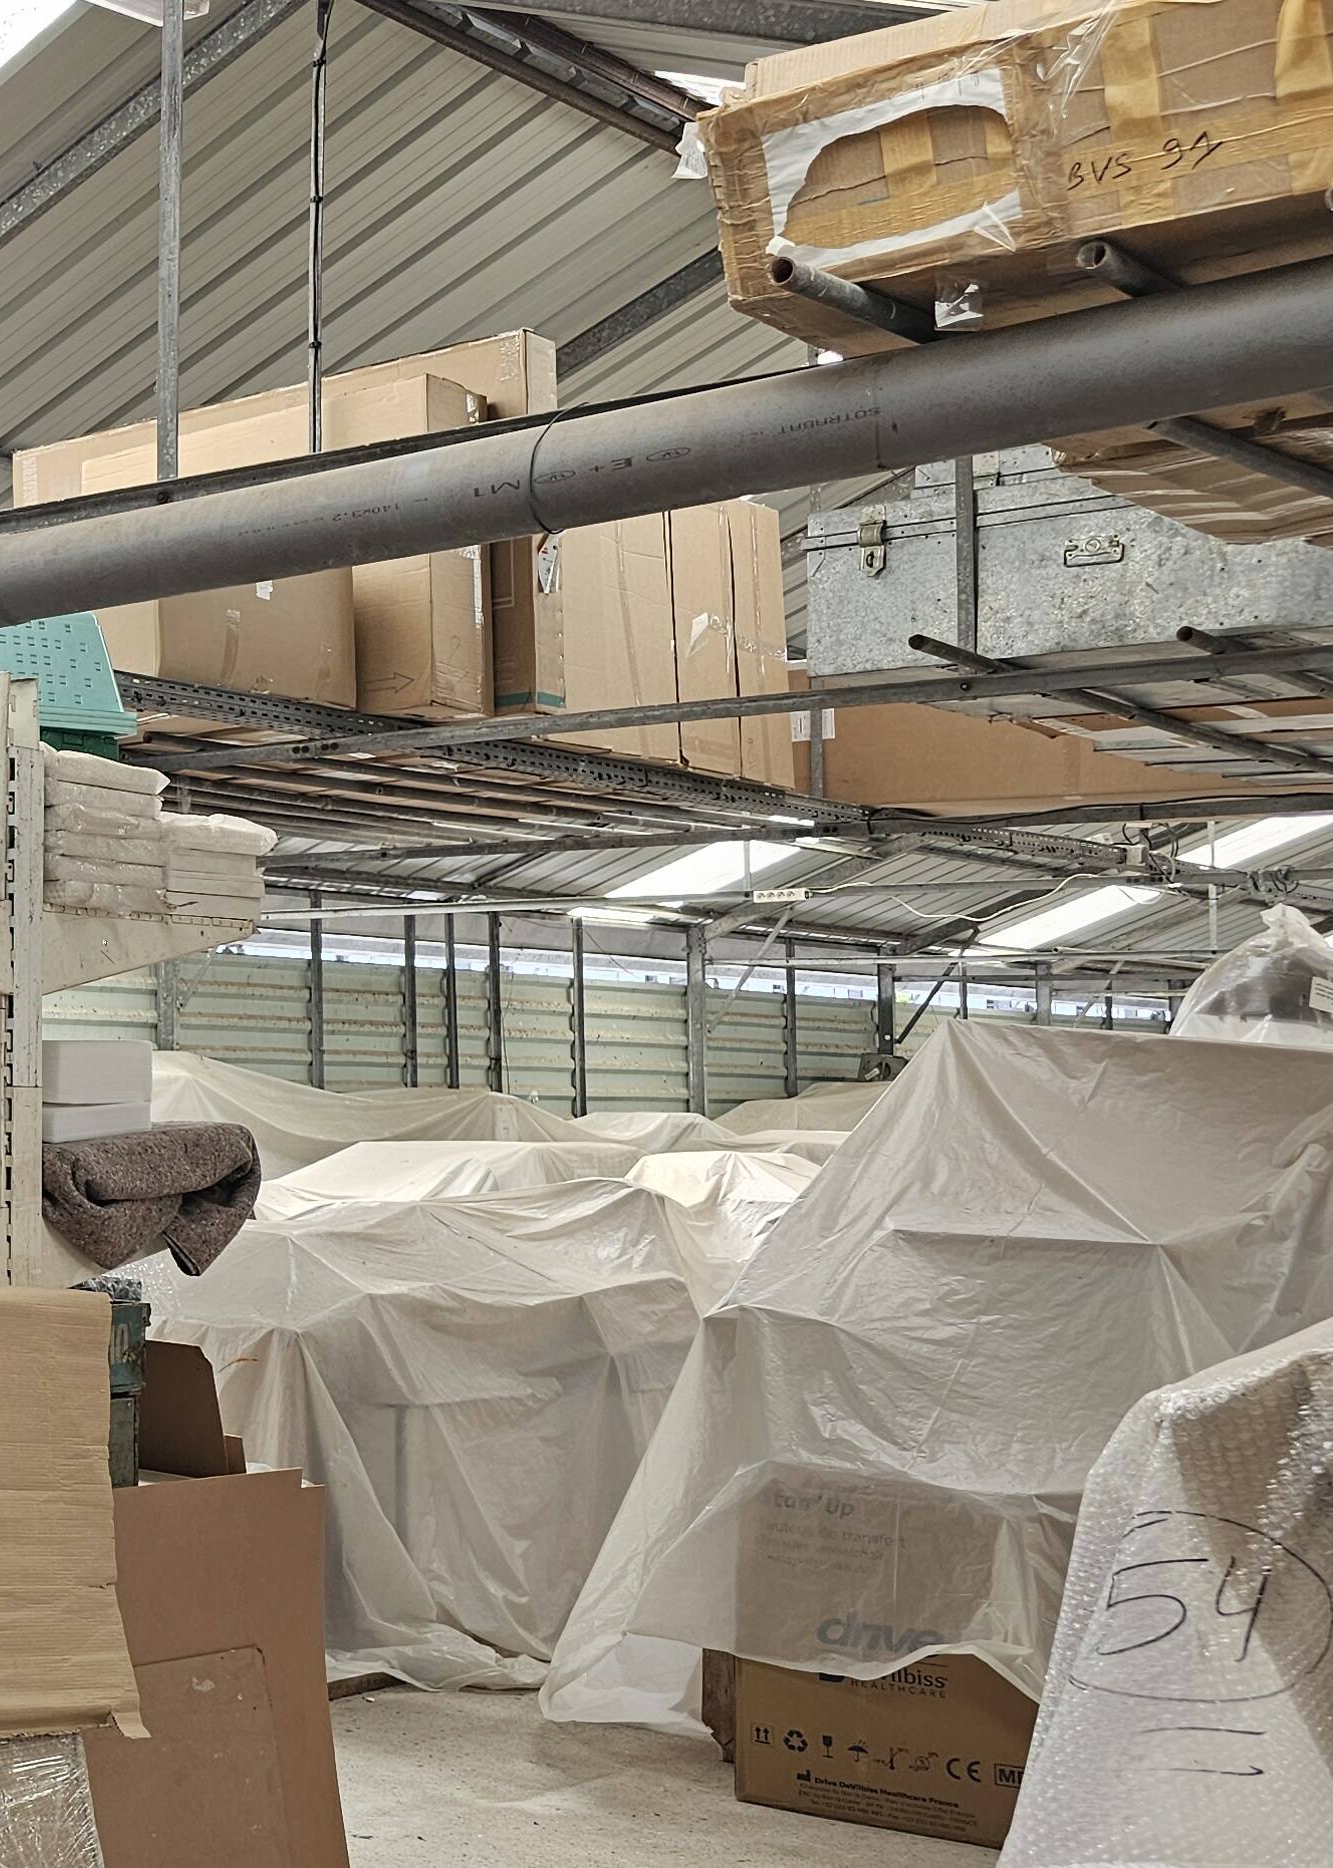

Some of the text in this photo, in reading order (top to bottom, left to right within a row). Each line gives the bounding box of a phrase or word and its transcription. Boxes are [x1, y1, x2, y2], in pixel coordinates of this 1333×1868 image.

[1067, 153, 1132, 191] BVS
[1095, 1555, 1271, 1662] 54
[851, 1680, 947, 1699] HEALTHCARE
[879, 1667, 949, 1689] ilbiss
